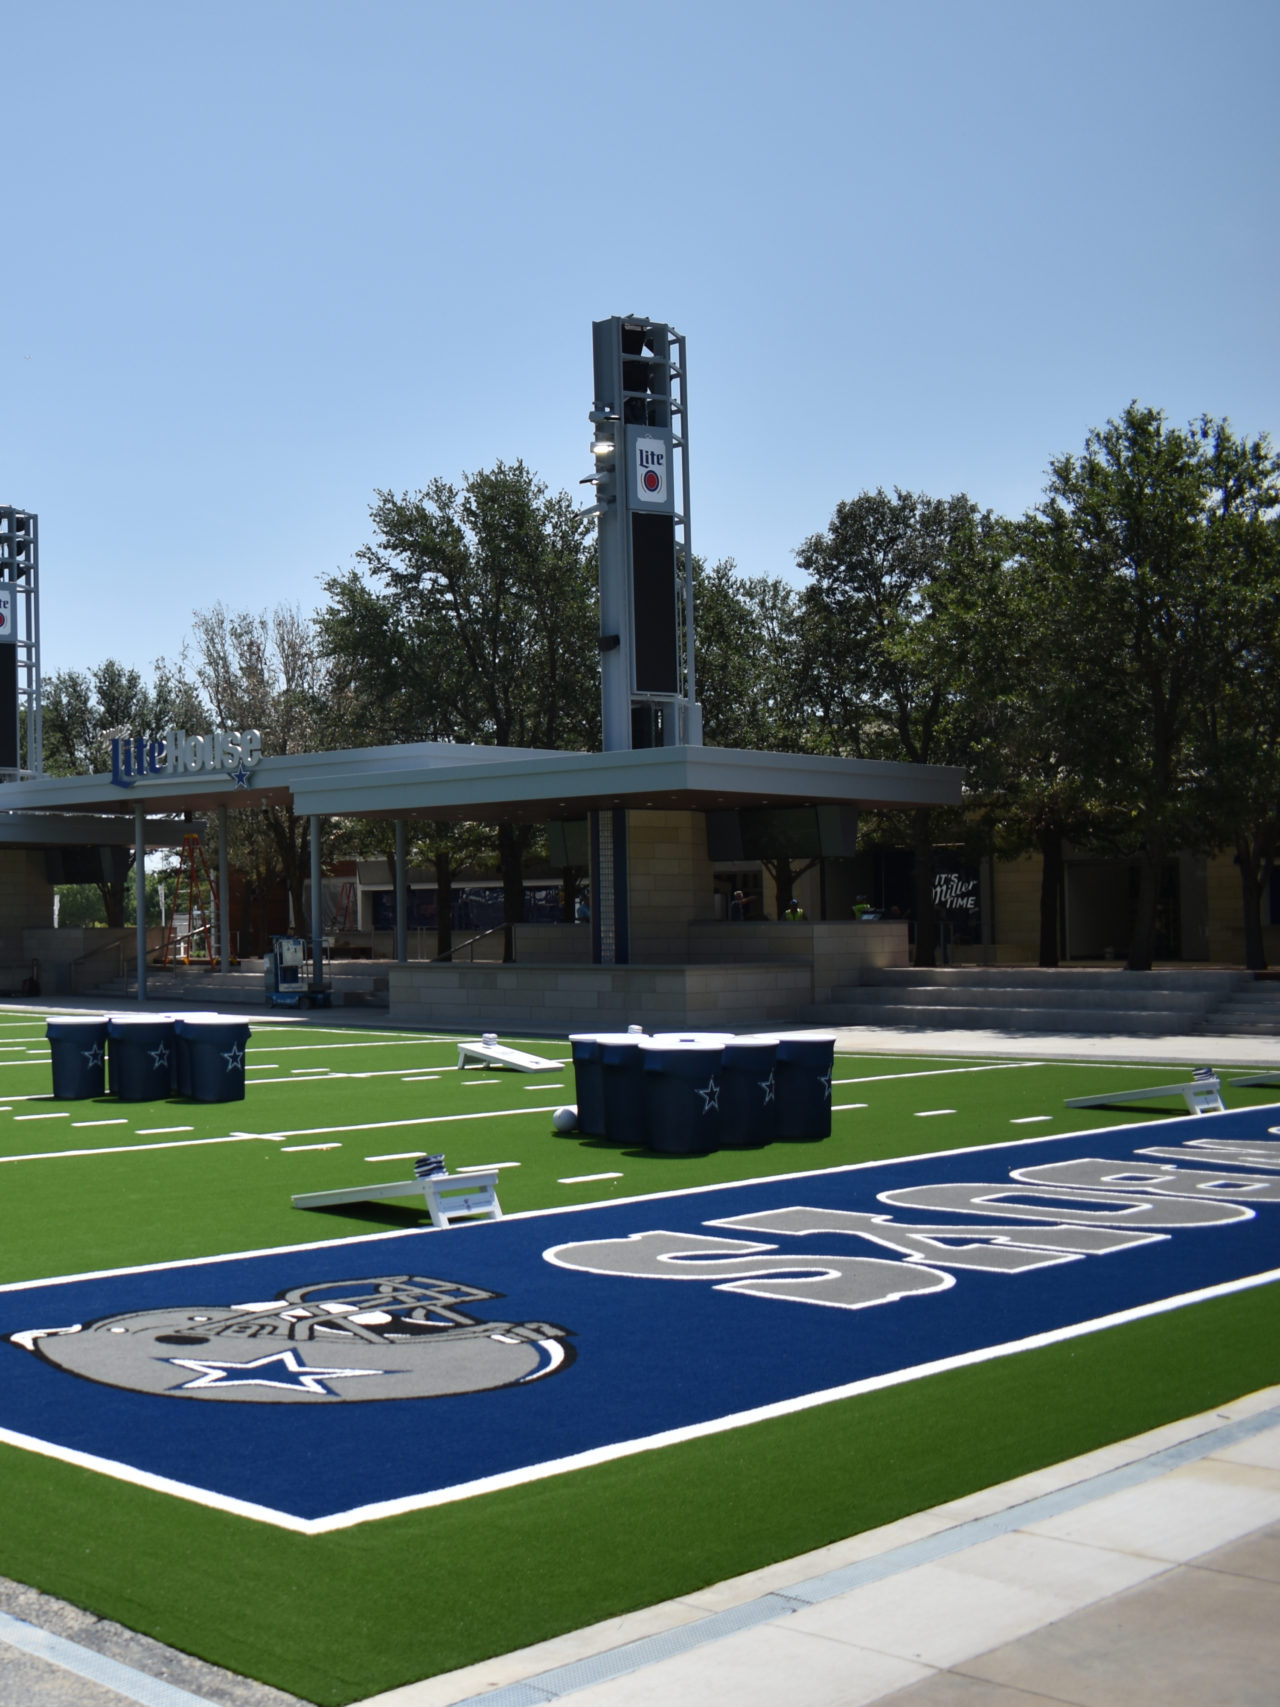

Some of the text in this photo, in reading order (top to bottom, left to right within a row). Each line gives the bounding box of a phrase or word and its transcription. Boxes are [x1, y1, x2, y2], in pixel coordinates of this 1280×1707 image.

[638, 448, 664, 469] Lite
[935, 873, 959, 885] IT'S
[932, 880, 978, 905] Miller
[946, 896, 976, 909] TIME
